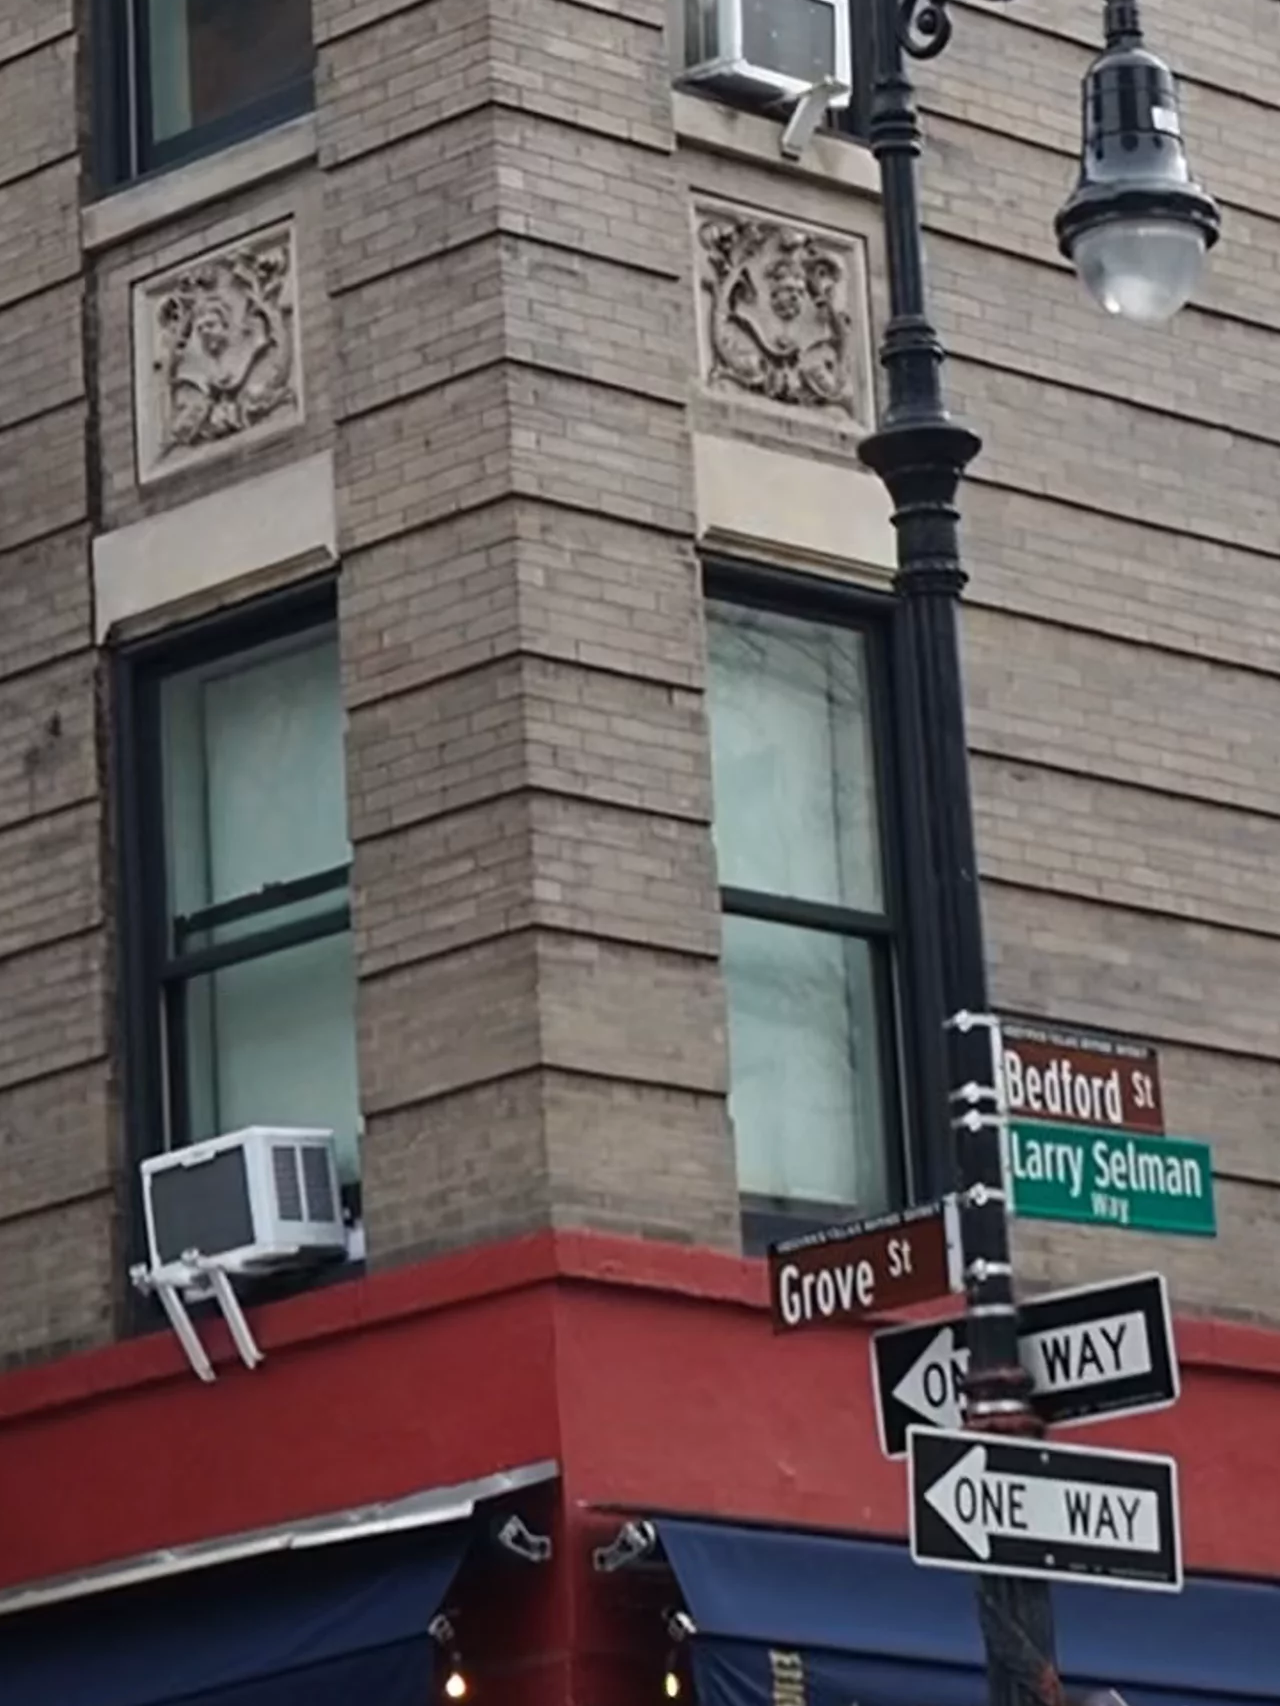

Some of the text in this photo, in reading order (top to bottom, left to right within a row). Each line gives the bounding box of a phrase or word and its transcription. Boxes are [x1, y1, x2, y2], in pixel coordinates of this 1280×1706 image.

[1004, 1049, 1155, 1124] Bedford St
[1011, 1131, 1203, 1199] Larry Selman
[1090, 1191, 1131, 1225] Way
[780, 1238, 913, 1325] Grove St
[1040, 1323, 1127, 1385] WAY
[954, 1476, 1141, 1542] ONE WAY
